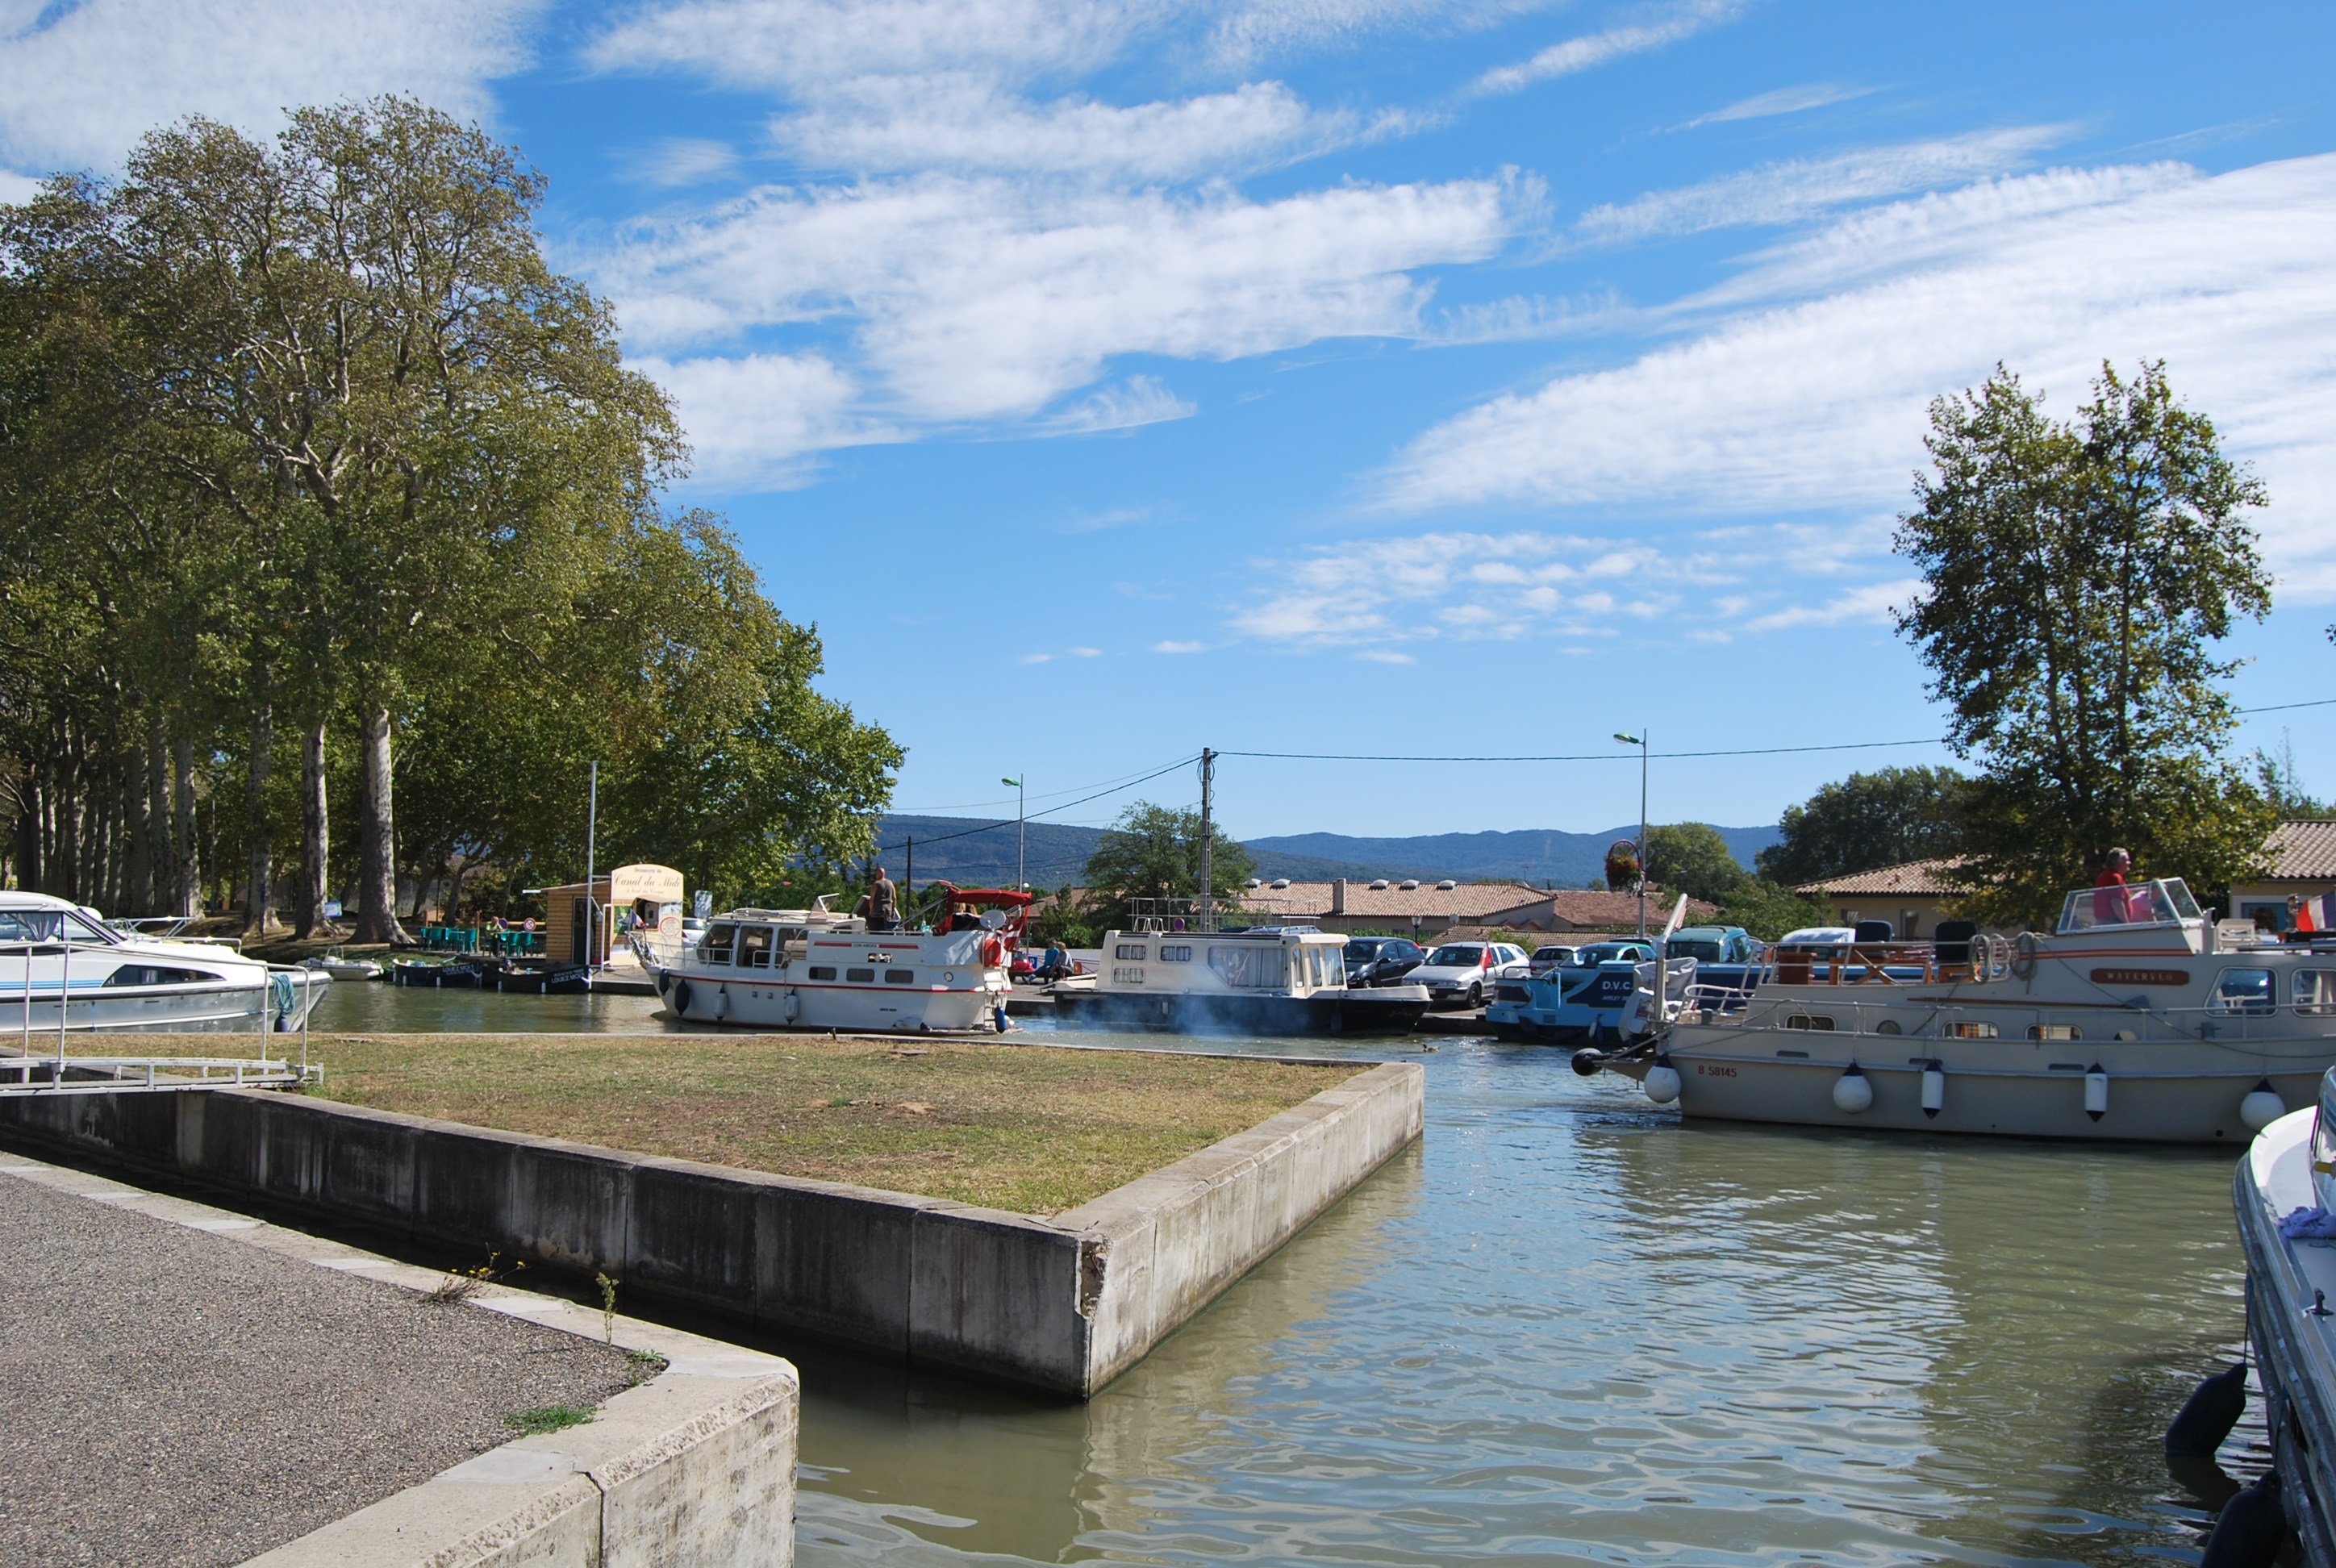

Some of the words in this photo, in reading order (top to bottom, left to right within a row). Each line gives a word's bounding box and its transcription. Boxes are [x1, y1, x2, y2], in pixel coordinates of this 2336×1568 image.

[615, 874, 643, 886] Canal
[644, 876, 655, 886] du
[659, 876, 682, 887] Midi
[1698, 1065, 1704, 1074] B
[1708, 1066, 1737, 1078] 58145
